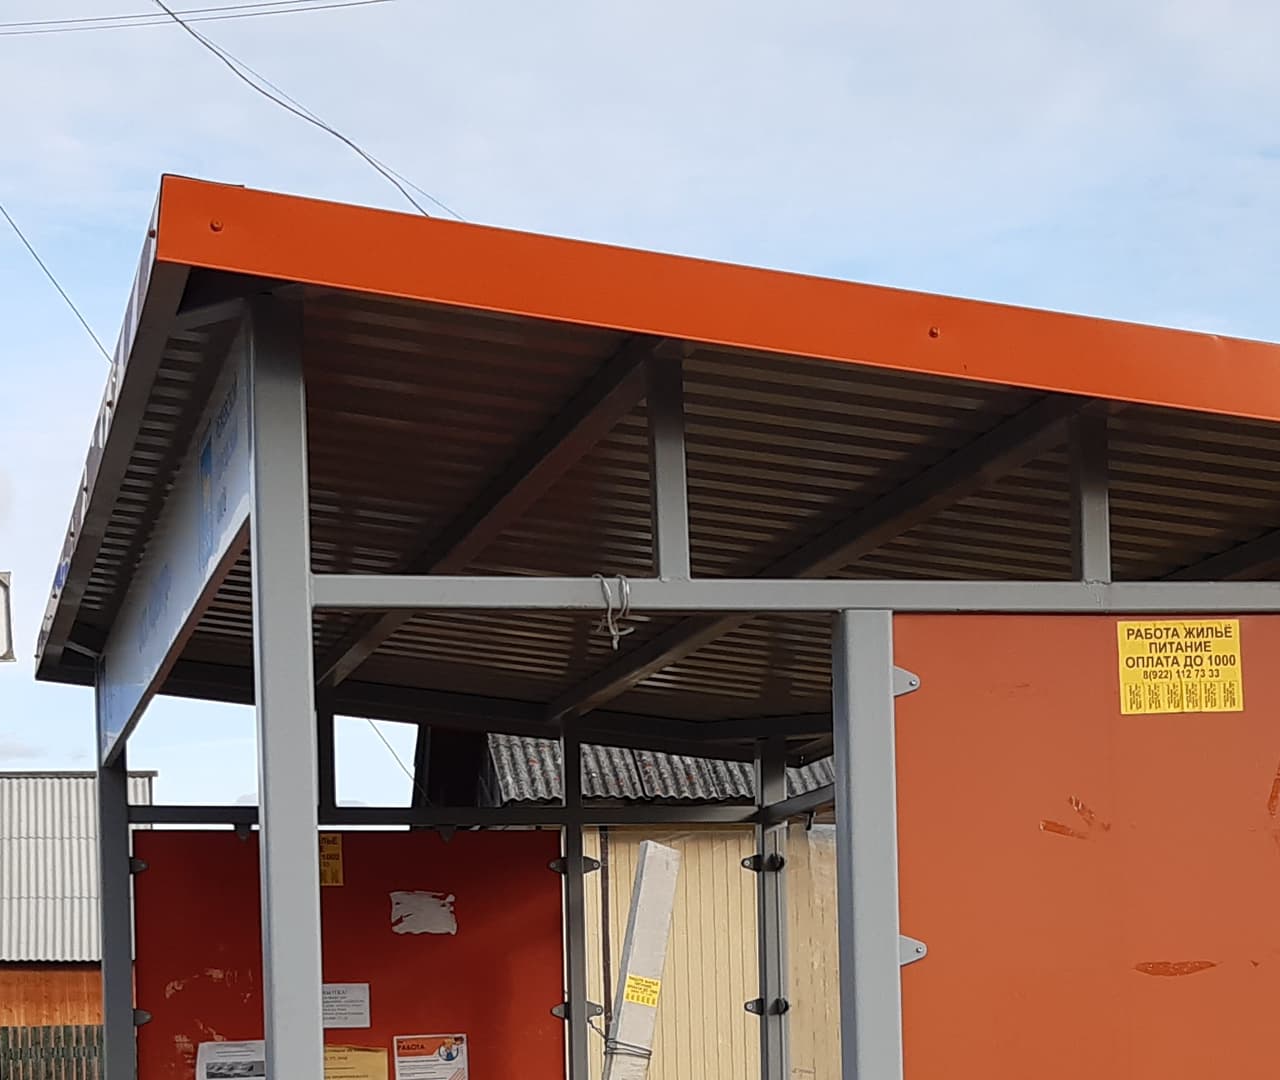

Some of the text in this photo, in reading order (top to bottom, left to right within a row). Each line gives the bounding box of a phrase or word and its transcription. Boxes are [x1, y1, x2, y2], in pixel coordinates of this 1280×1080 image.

[1126, 624, 1233, 640] РАБОТА ЖИЛЬЁ
[1149, 641, 1212, 654] ПИТАНИЕ
[1125, 654, 1236, 669] ОПЛАТА ДО 1000
[1143, 668, 1220, 681] 8(922) 112 73 33
